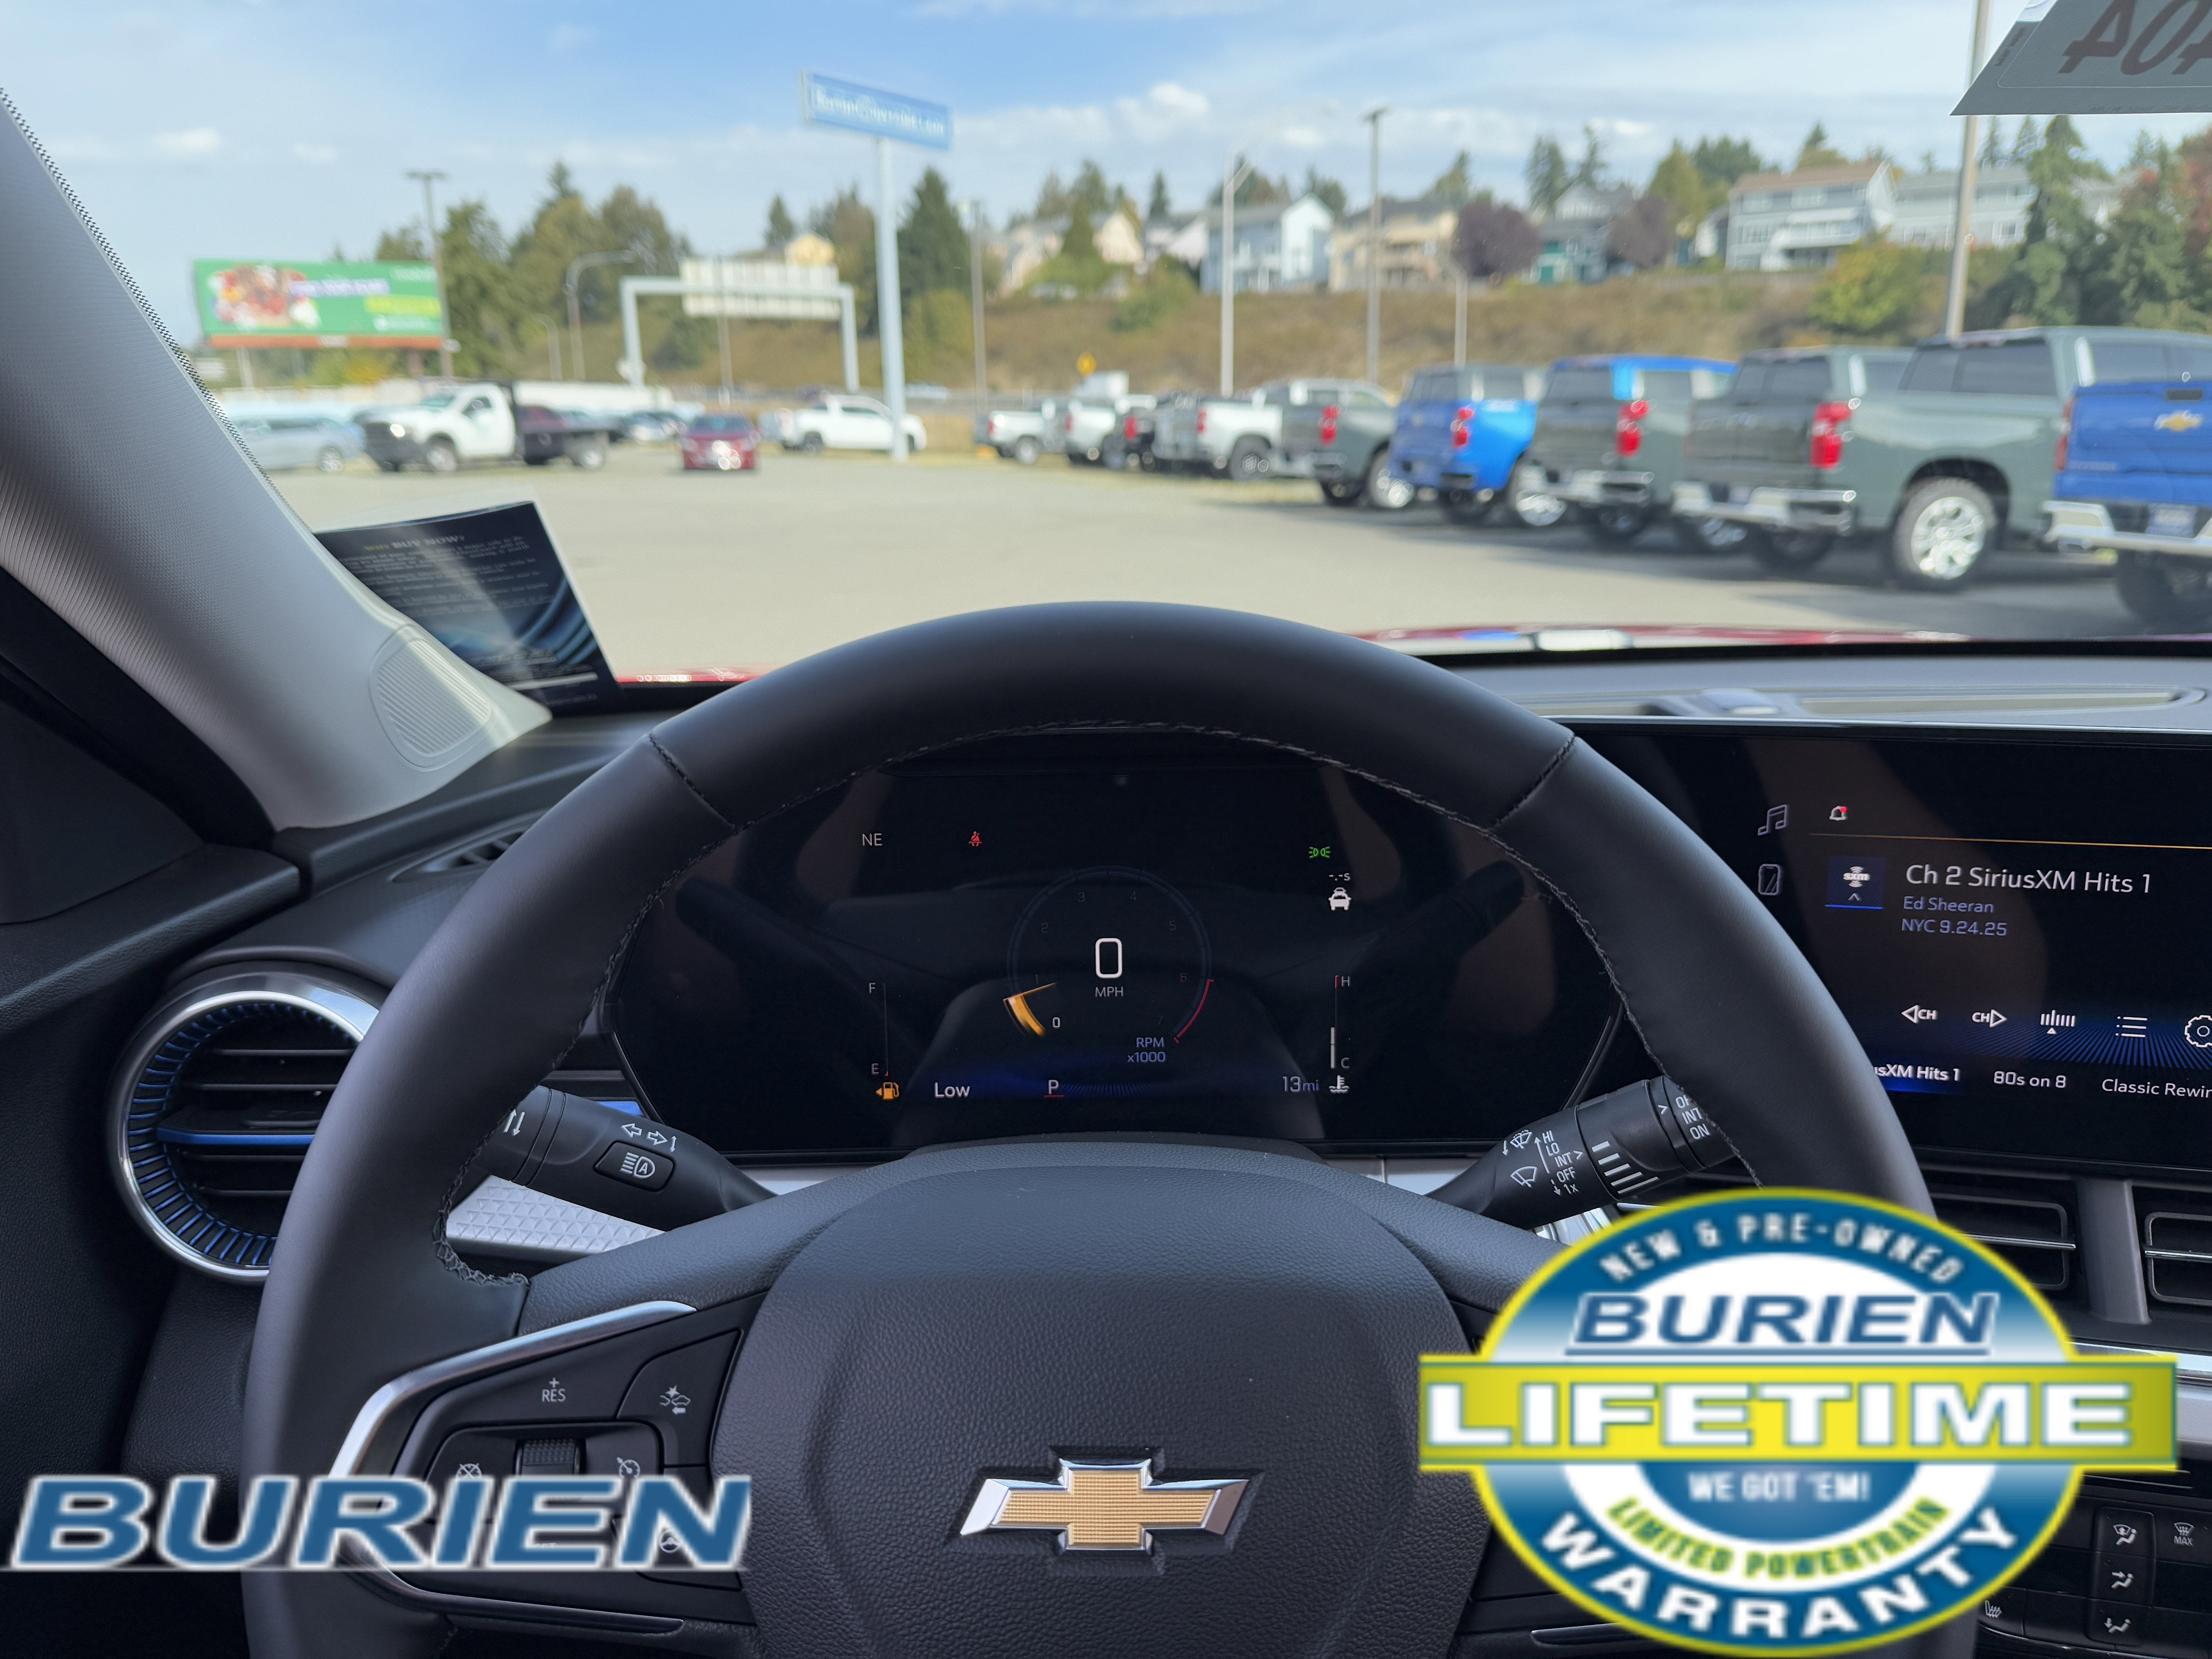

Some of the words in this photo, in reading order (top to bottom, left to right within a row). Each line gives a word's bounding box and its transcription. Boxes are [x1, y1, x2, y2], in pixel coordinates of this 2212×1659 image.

[862, 833, 883, 846] NE
[1906, 864, 1938, 884] Ch
[1946, 866, 1961, 885] 2
[1968, 867, 2075, 890] SiriusXM
[2085, 872, 2133, 893] Hits
[2143, 874, 2150, 893] 1
[1077, 891, 1086, 902] 3
[1129, 891, 1137, 902] 4
[1904, 896, 1924, 910] Ed
[1928, 897, 1994, 913] Sheeran
[1041, 922, 1049, 933] 2
[1169, 921, 1176, 931] 5
[1902, 919, 1935, 933] NYC
[1940, 920, 2007, 936] 9.24.25
[1095, 938, 1122, 978] 0
[869, 982, 876, 993] F
[1341, 976, 1350, 986] H
[1095, 986, 1123, 997] MPH
[1918, 1009, 1937, 1020] CH
[1972, 1012, 1990, 1023] CH
[1053, 1017, 1060, 1028] 0
[1136, 1037, 1164, 1048] RPM
[1127, 1051, 1166, 1063] x1000
[1341, 1057, 1349, 1068] C
[871, 1063, 879, 1074] E
[1917, 1066, 1950, 1081] Hits
[1953, 1068, 1960, 1082] 1
[1994, 1071, 2025, 1085] 80s
[2029, 1077, 2050, 1087] on
[2055, 1075, 2066, 1088] 8
[935, 1082, 970, 1097] Low
[1048, 1080, 1059, 1094] P
[2102, 1078, 2159, 1095] Classic
[1681, 1107, 1702, 1124] INT
[1542, 1130, 1554, 1144] HI
[1690, 1123, 1710, 1139] ON
[1546, 1142, 1559, 1156] LO
[1554, 1152, 1572, 1167] INT
[1556, 1166, 1575, 1183] OFF
[1563, 1183, 1578, 1194] 1x
[542, 1389, 566, 1403] RES
[2174, 1536, 2193, 1546] MAX
